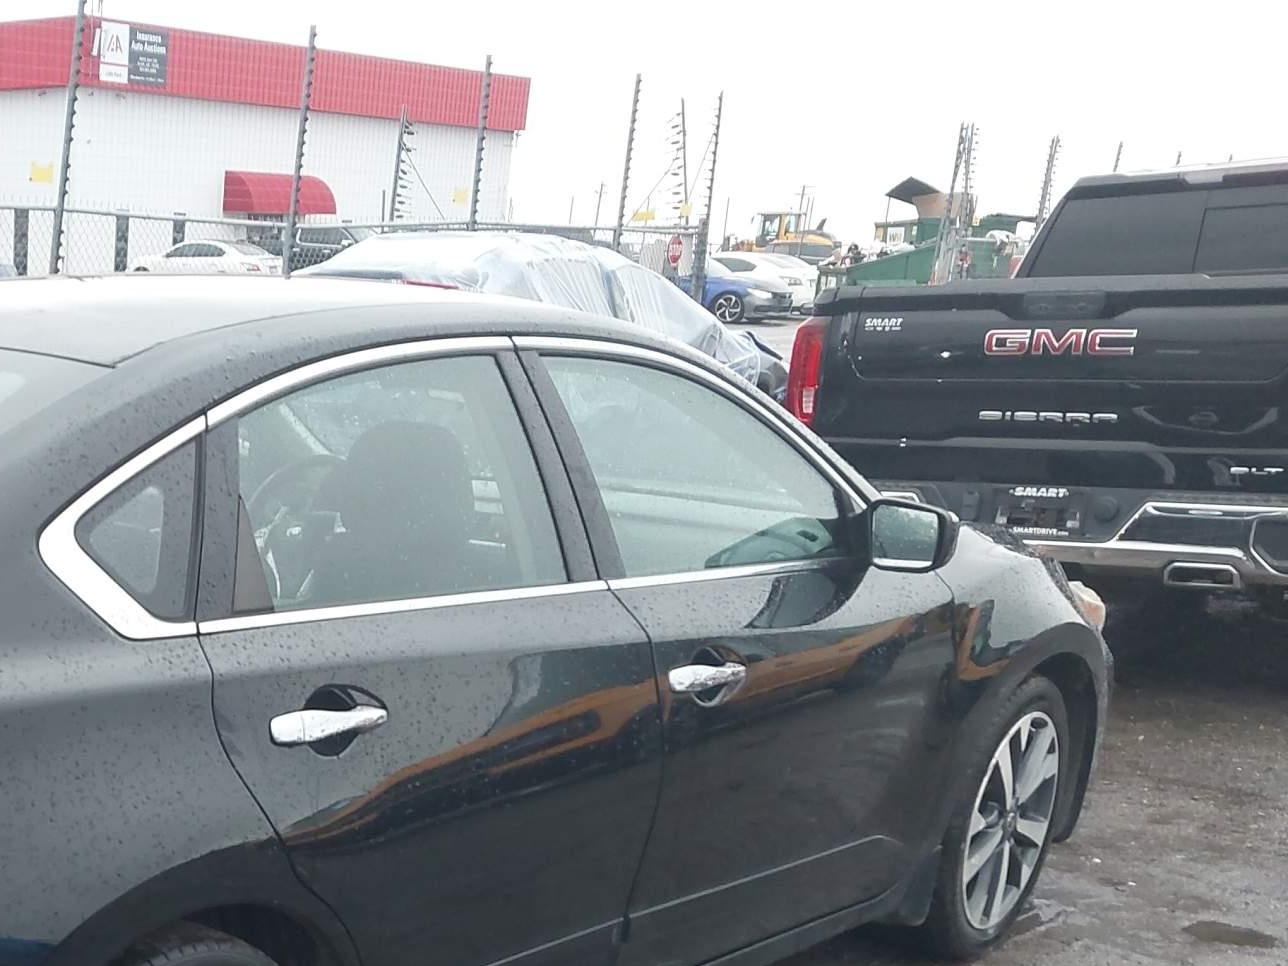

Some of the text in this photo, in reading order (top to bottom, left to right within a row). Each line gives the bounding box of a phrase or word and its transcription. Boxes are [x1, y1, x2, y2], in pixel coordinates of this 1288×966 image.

[864, 317, 904, 327] SMART
[984, 328, 1138, 355] GMC
[978, 410, 1119, 424] SIERRA
[1014, 486, 1068, 498] SMART
